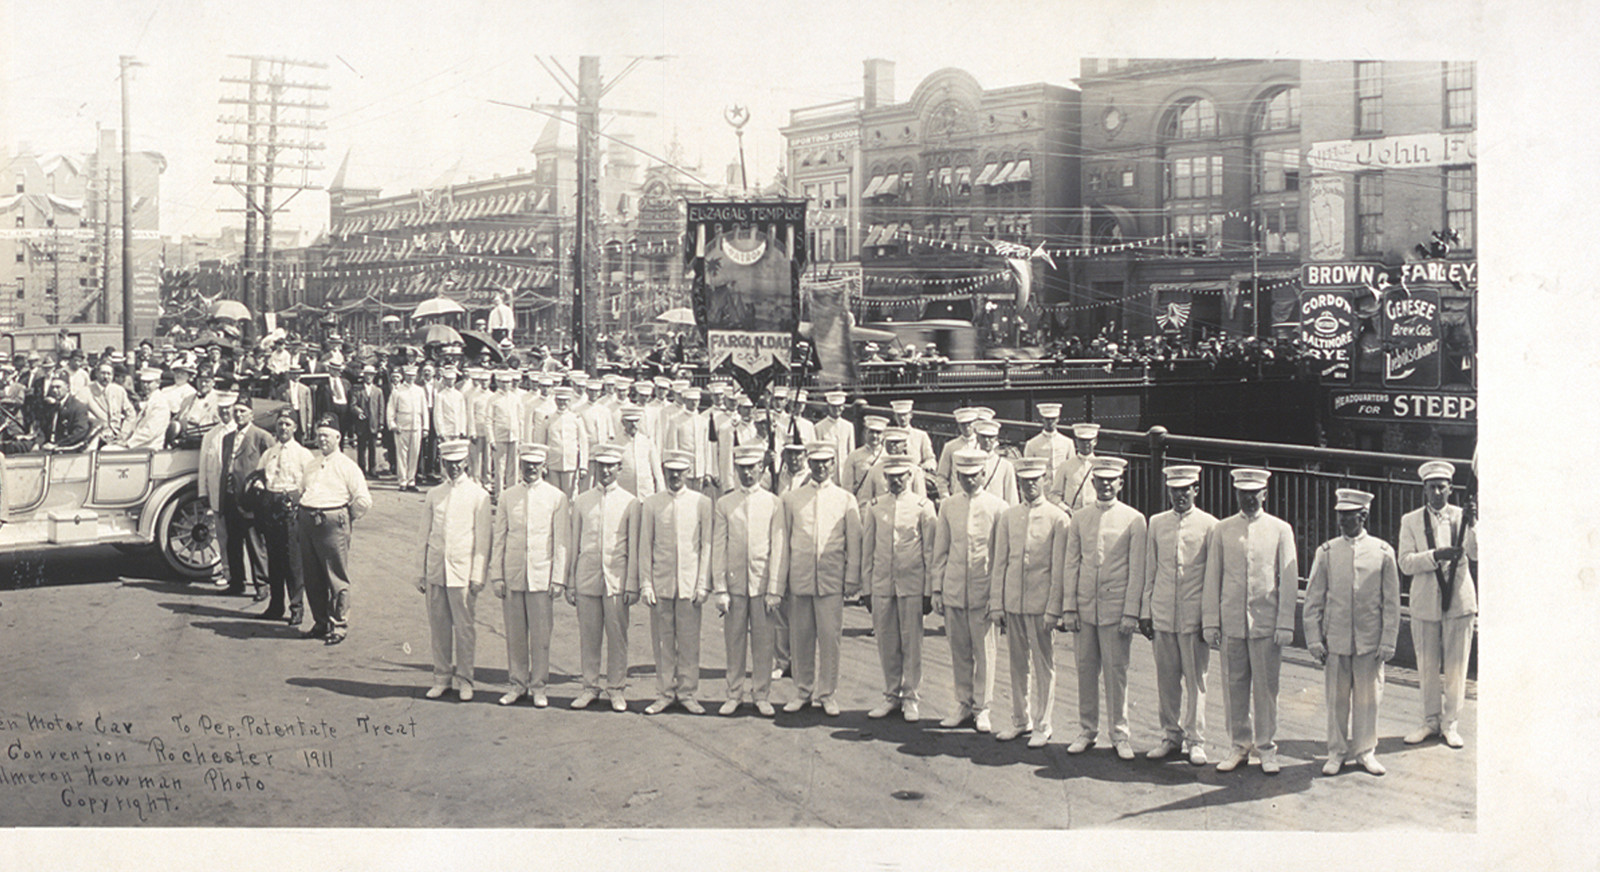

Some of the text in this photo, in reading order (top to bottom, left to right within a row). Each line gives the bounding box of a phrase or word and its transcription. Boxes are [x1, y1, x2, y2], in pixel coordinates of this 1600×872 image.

[1356, 142, 1431, 165] John
[750, 207, 802, 221] TEMPLE
[1308, 265, 1375, 285] BROWN
[1386, 299, 1437, 320] GENESEE
[1302, 331, 1353, 349] BALTIMORE
[1335, 393, 1389, 410] HEADQUARTERS
[1358, 405, 1381, 415] FOR
